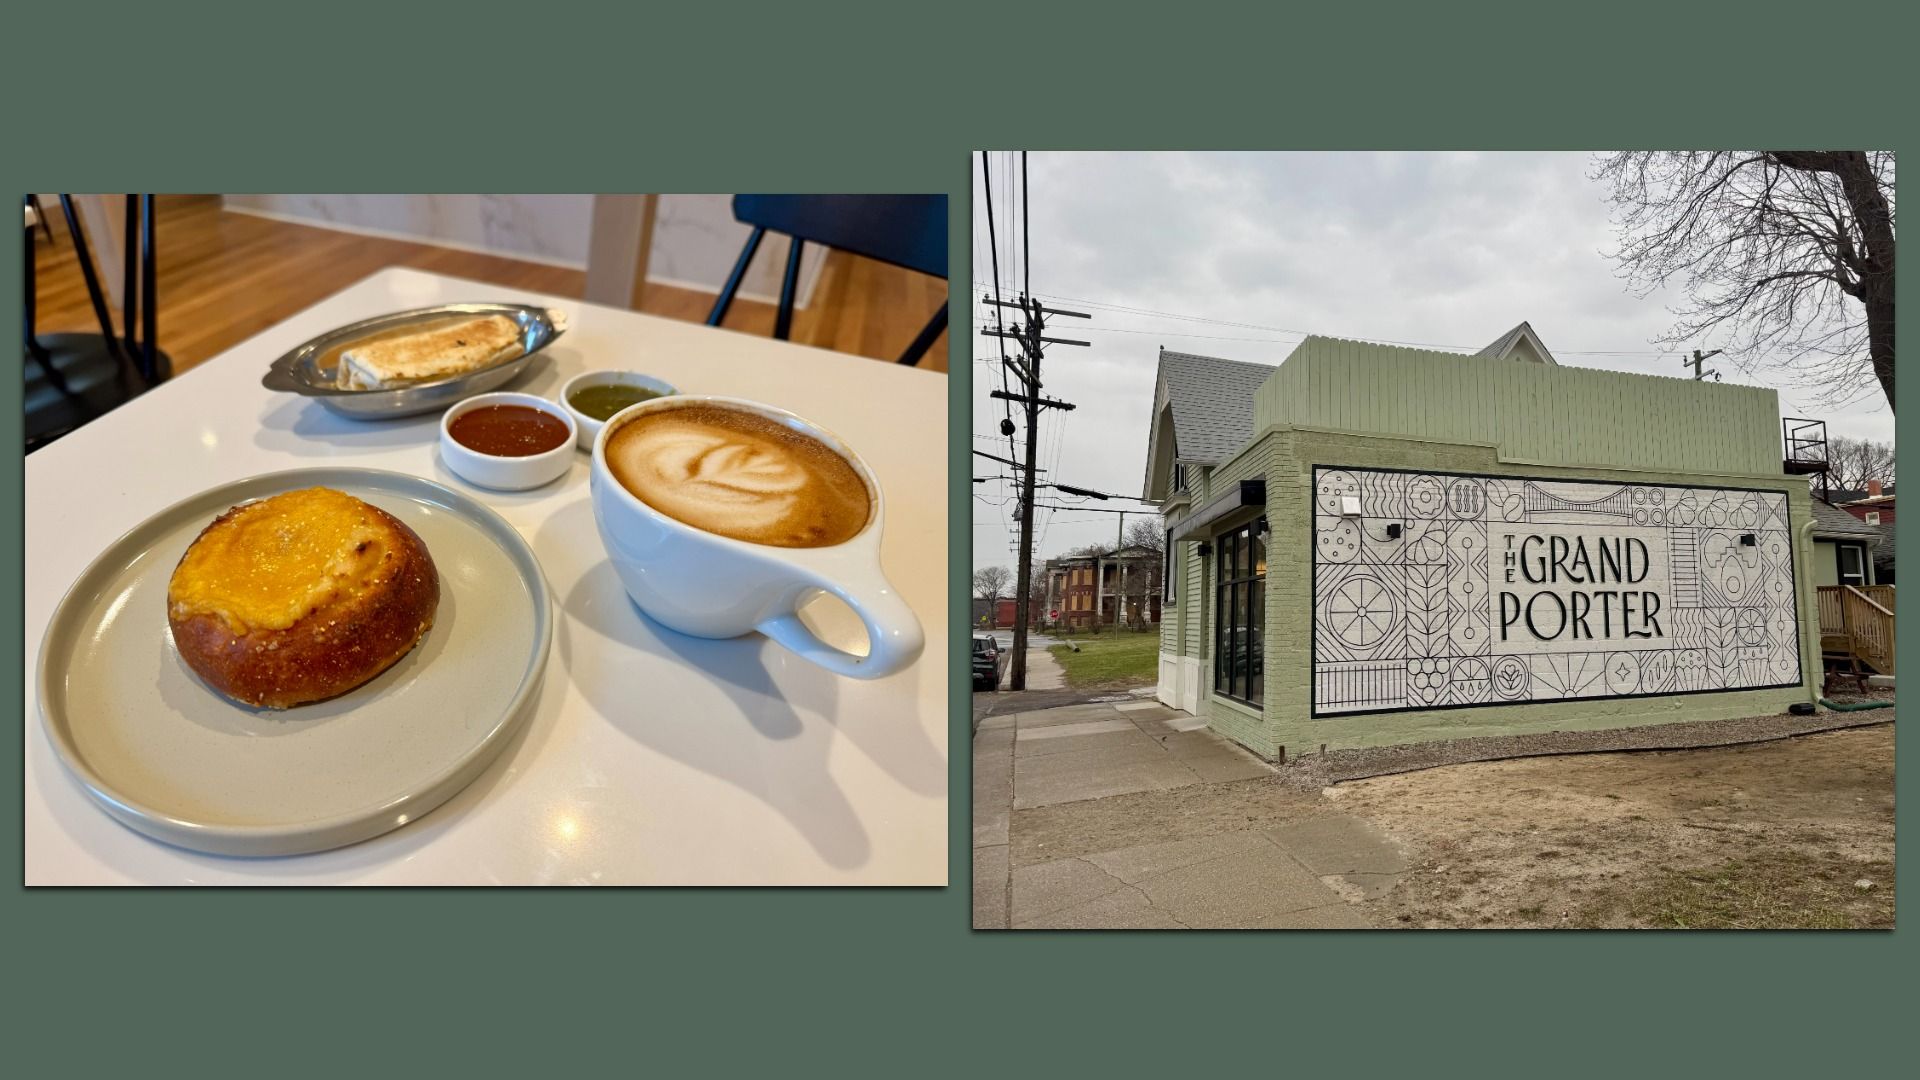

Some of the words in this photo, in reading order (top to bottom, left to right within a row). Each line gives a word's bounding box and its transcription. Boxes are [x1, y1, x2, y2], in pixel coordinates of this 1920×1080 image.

[1504, 534, 1516, 583] THE
[1520, 534, 1650, 584] GRAND
[1500, 590, 1664, 641] PORTER
